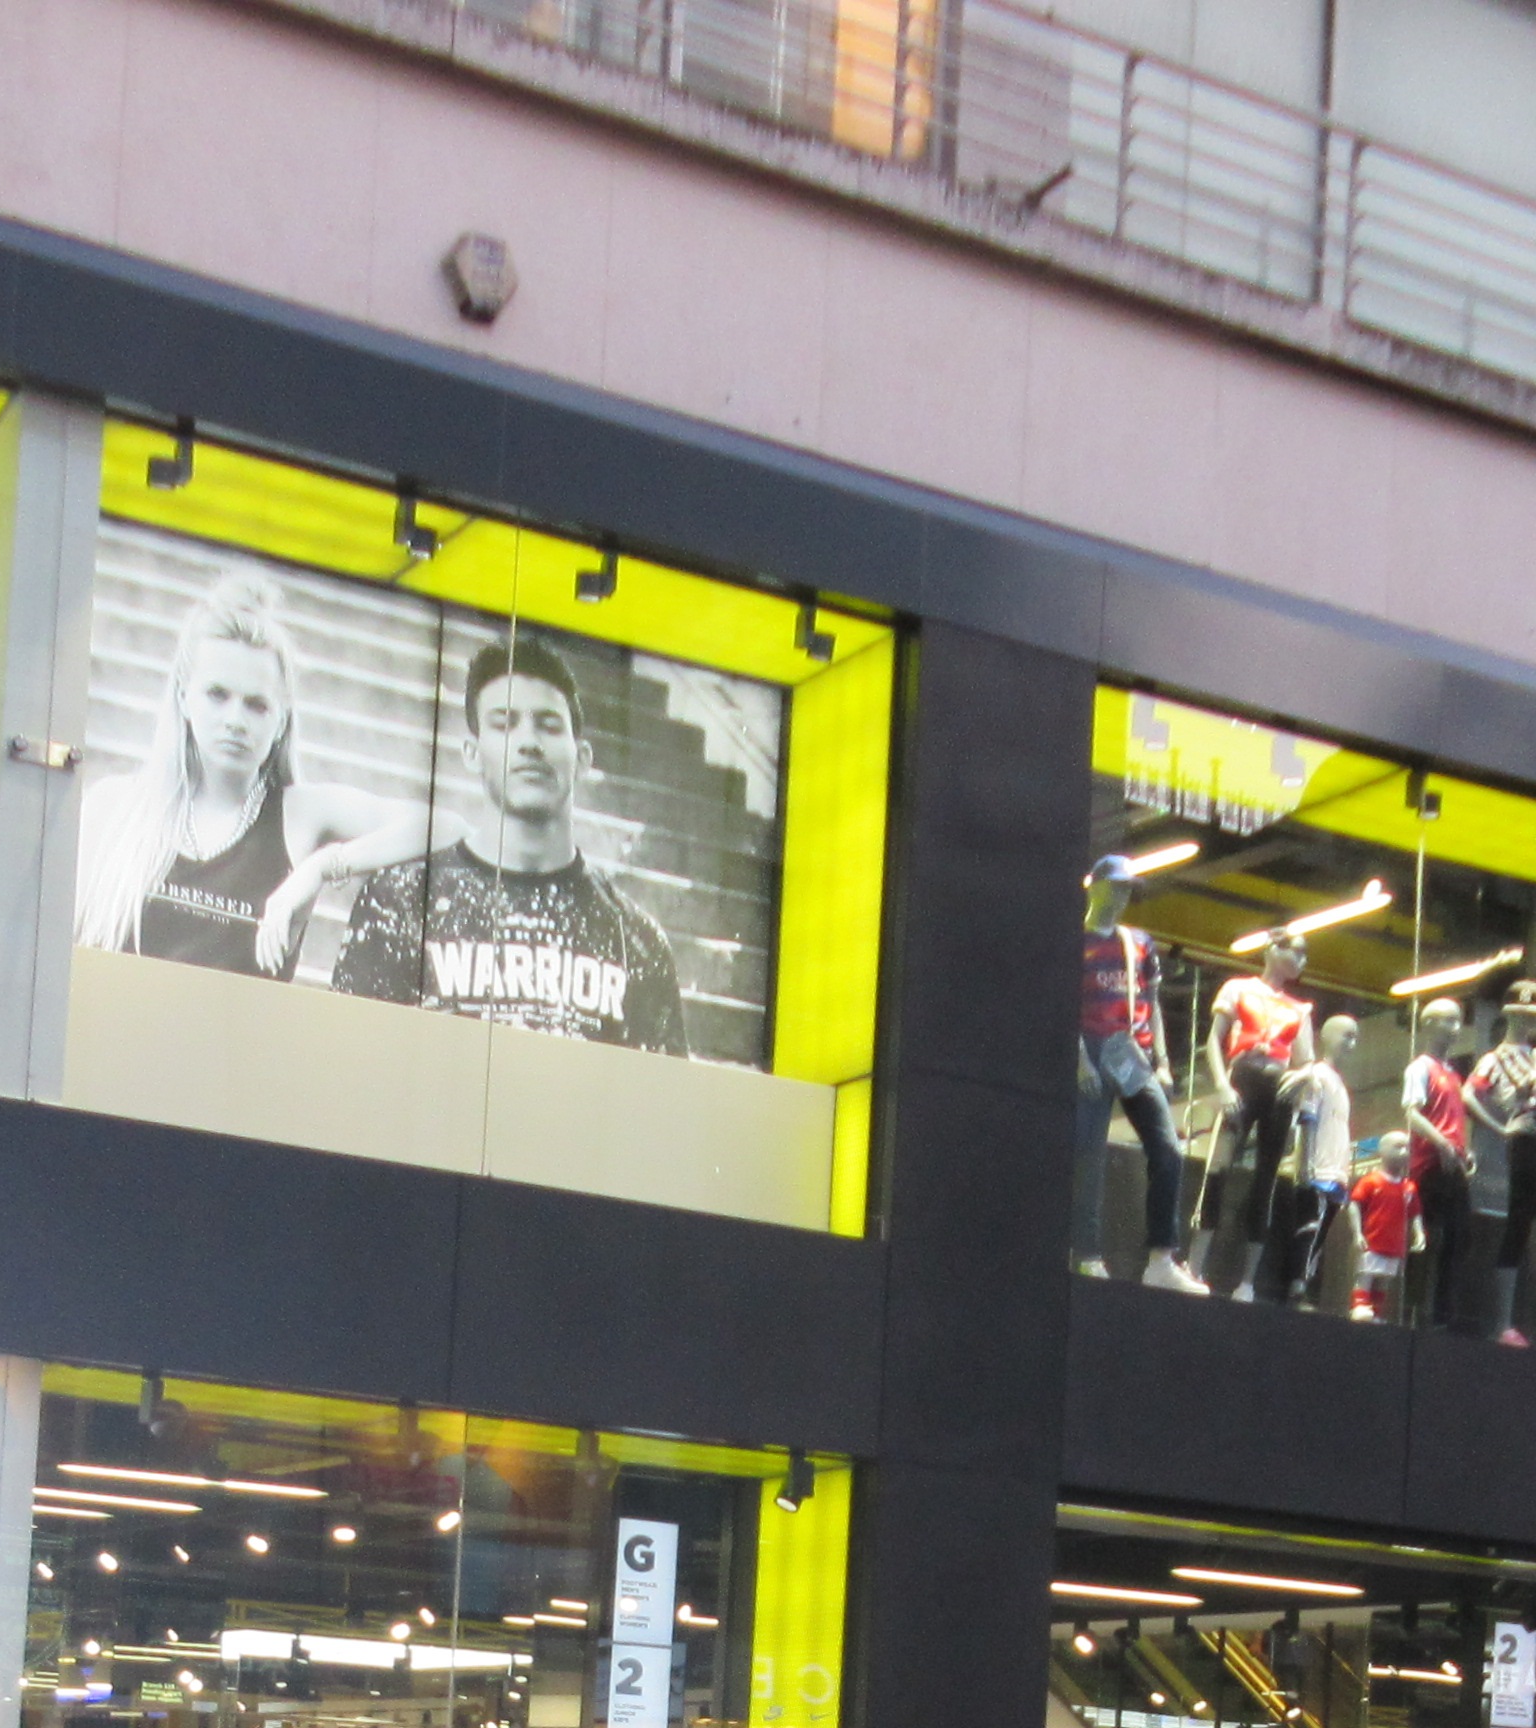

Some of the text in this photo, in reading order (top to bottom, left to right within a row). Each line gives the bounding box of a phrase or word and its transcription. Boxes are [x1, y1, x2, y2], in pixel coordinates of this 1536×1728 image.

[425, 940, 627, 1021] WARRIOR
[623, 1534, 655, 1573] G
[1498, 1633, 1518, 1665] 2
[615, 1657, 643, 1697] 2
